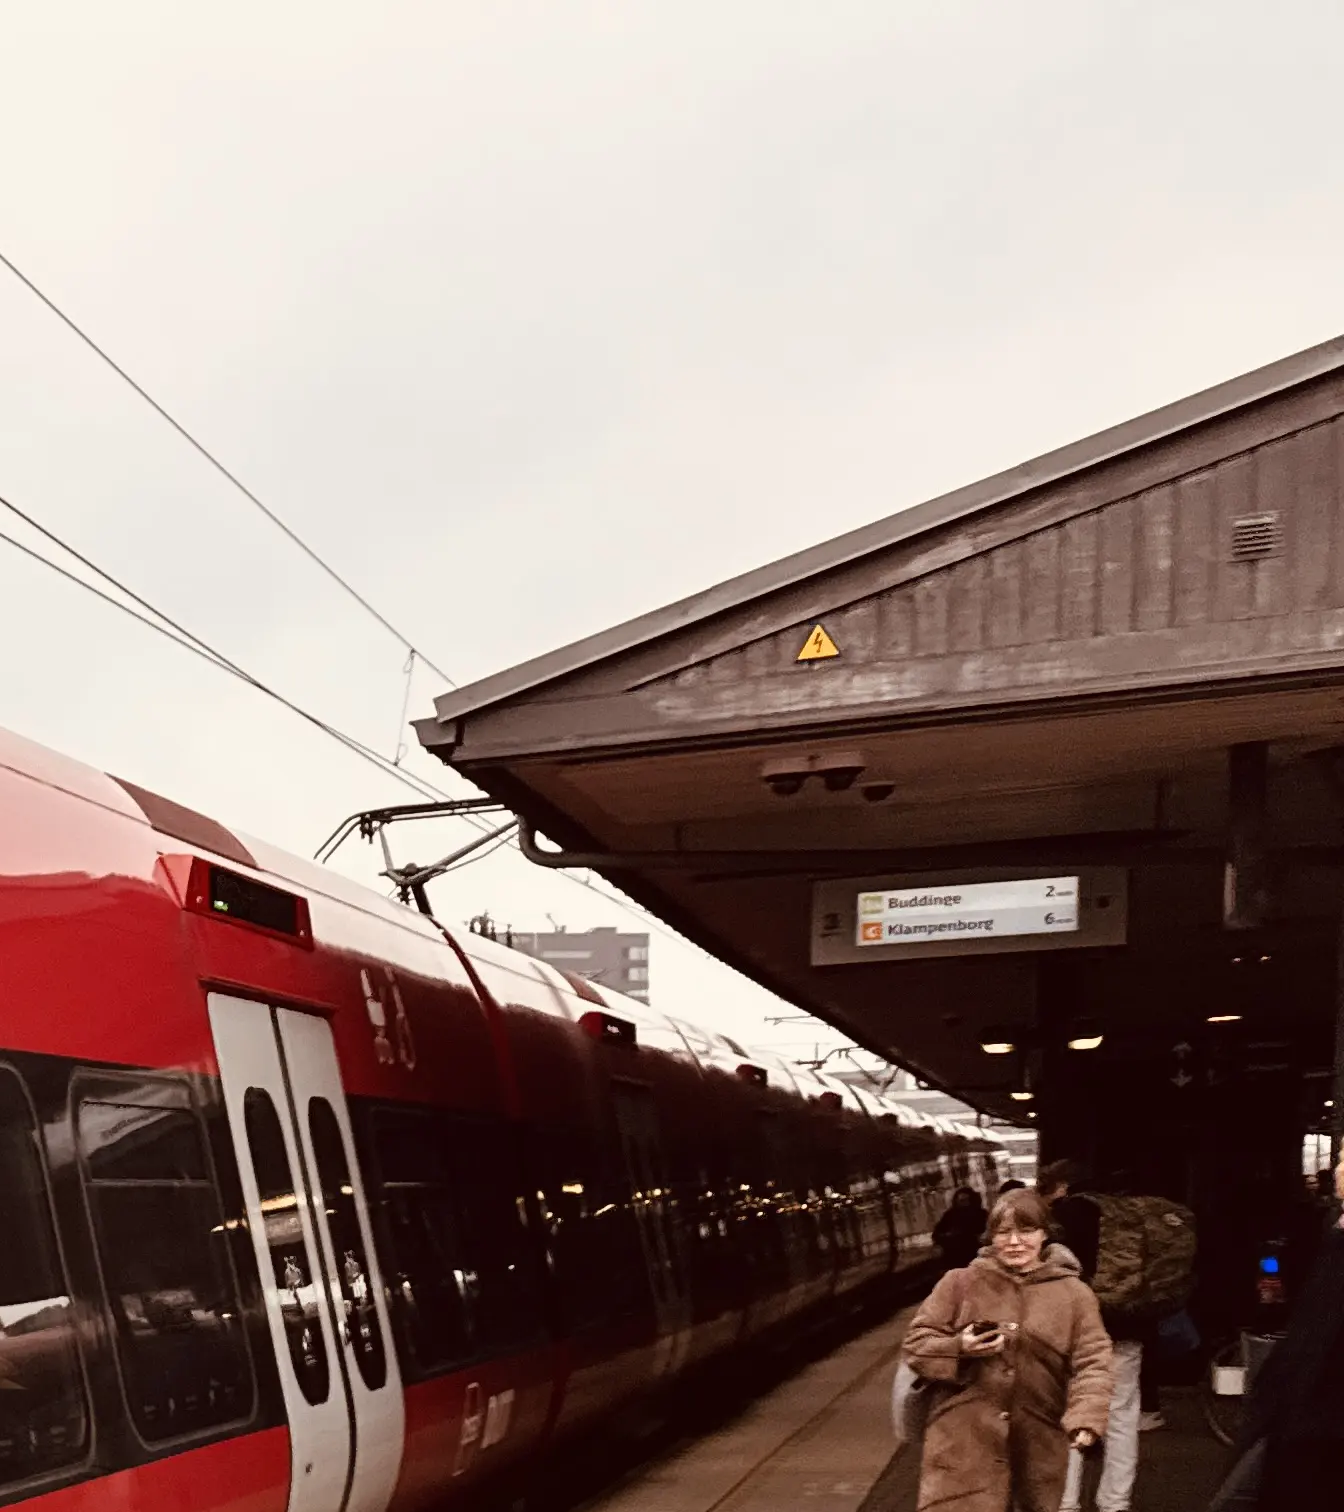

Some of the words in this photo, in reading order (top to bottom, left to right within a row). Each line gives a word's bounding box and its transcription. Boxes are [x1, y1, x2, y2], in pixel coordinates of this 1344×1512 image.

[887, 893, 962, 909] Buddinge
[1045, 885, 1056, 898] 2
[887, 918, 995, 937] Klampenborg
[1044, 912, 1055, 925] 6
